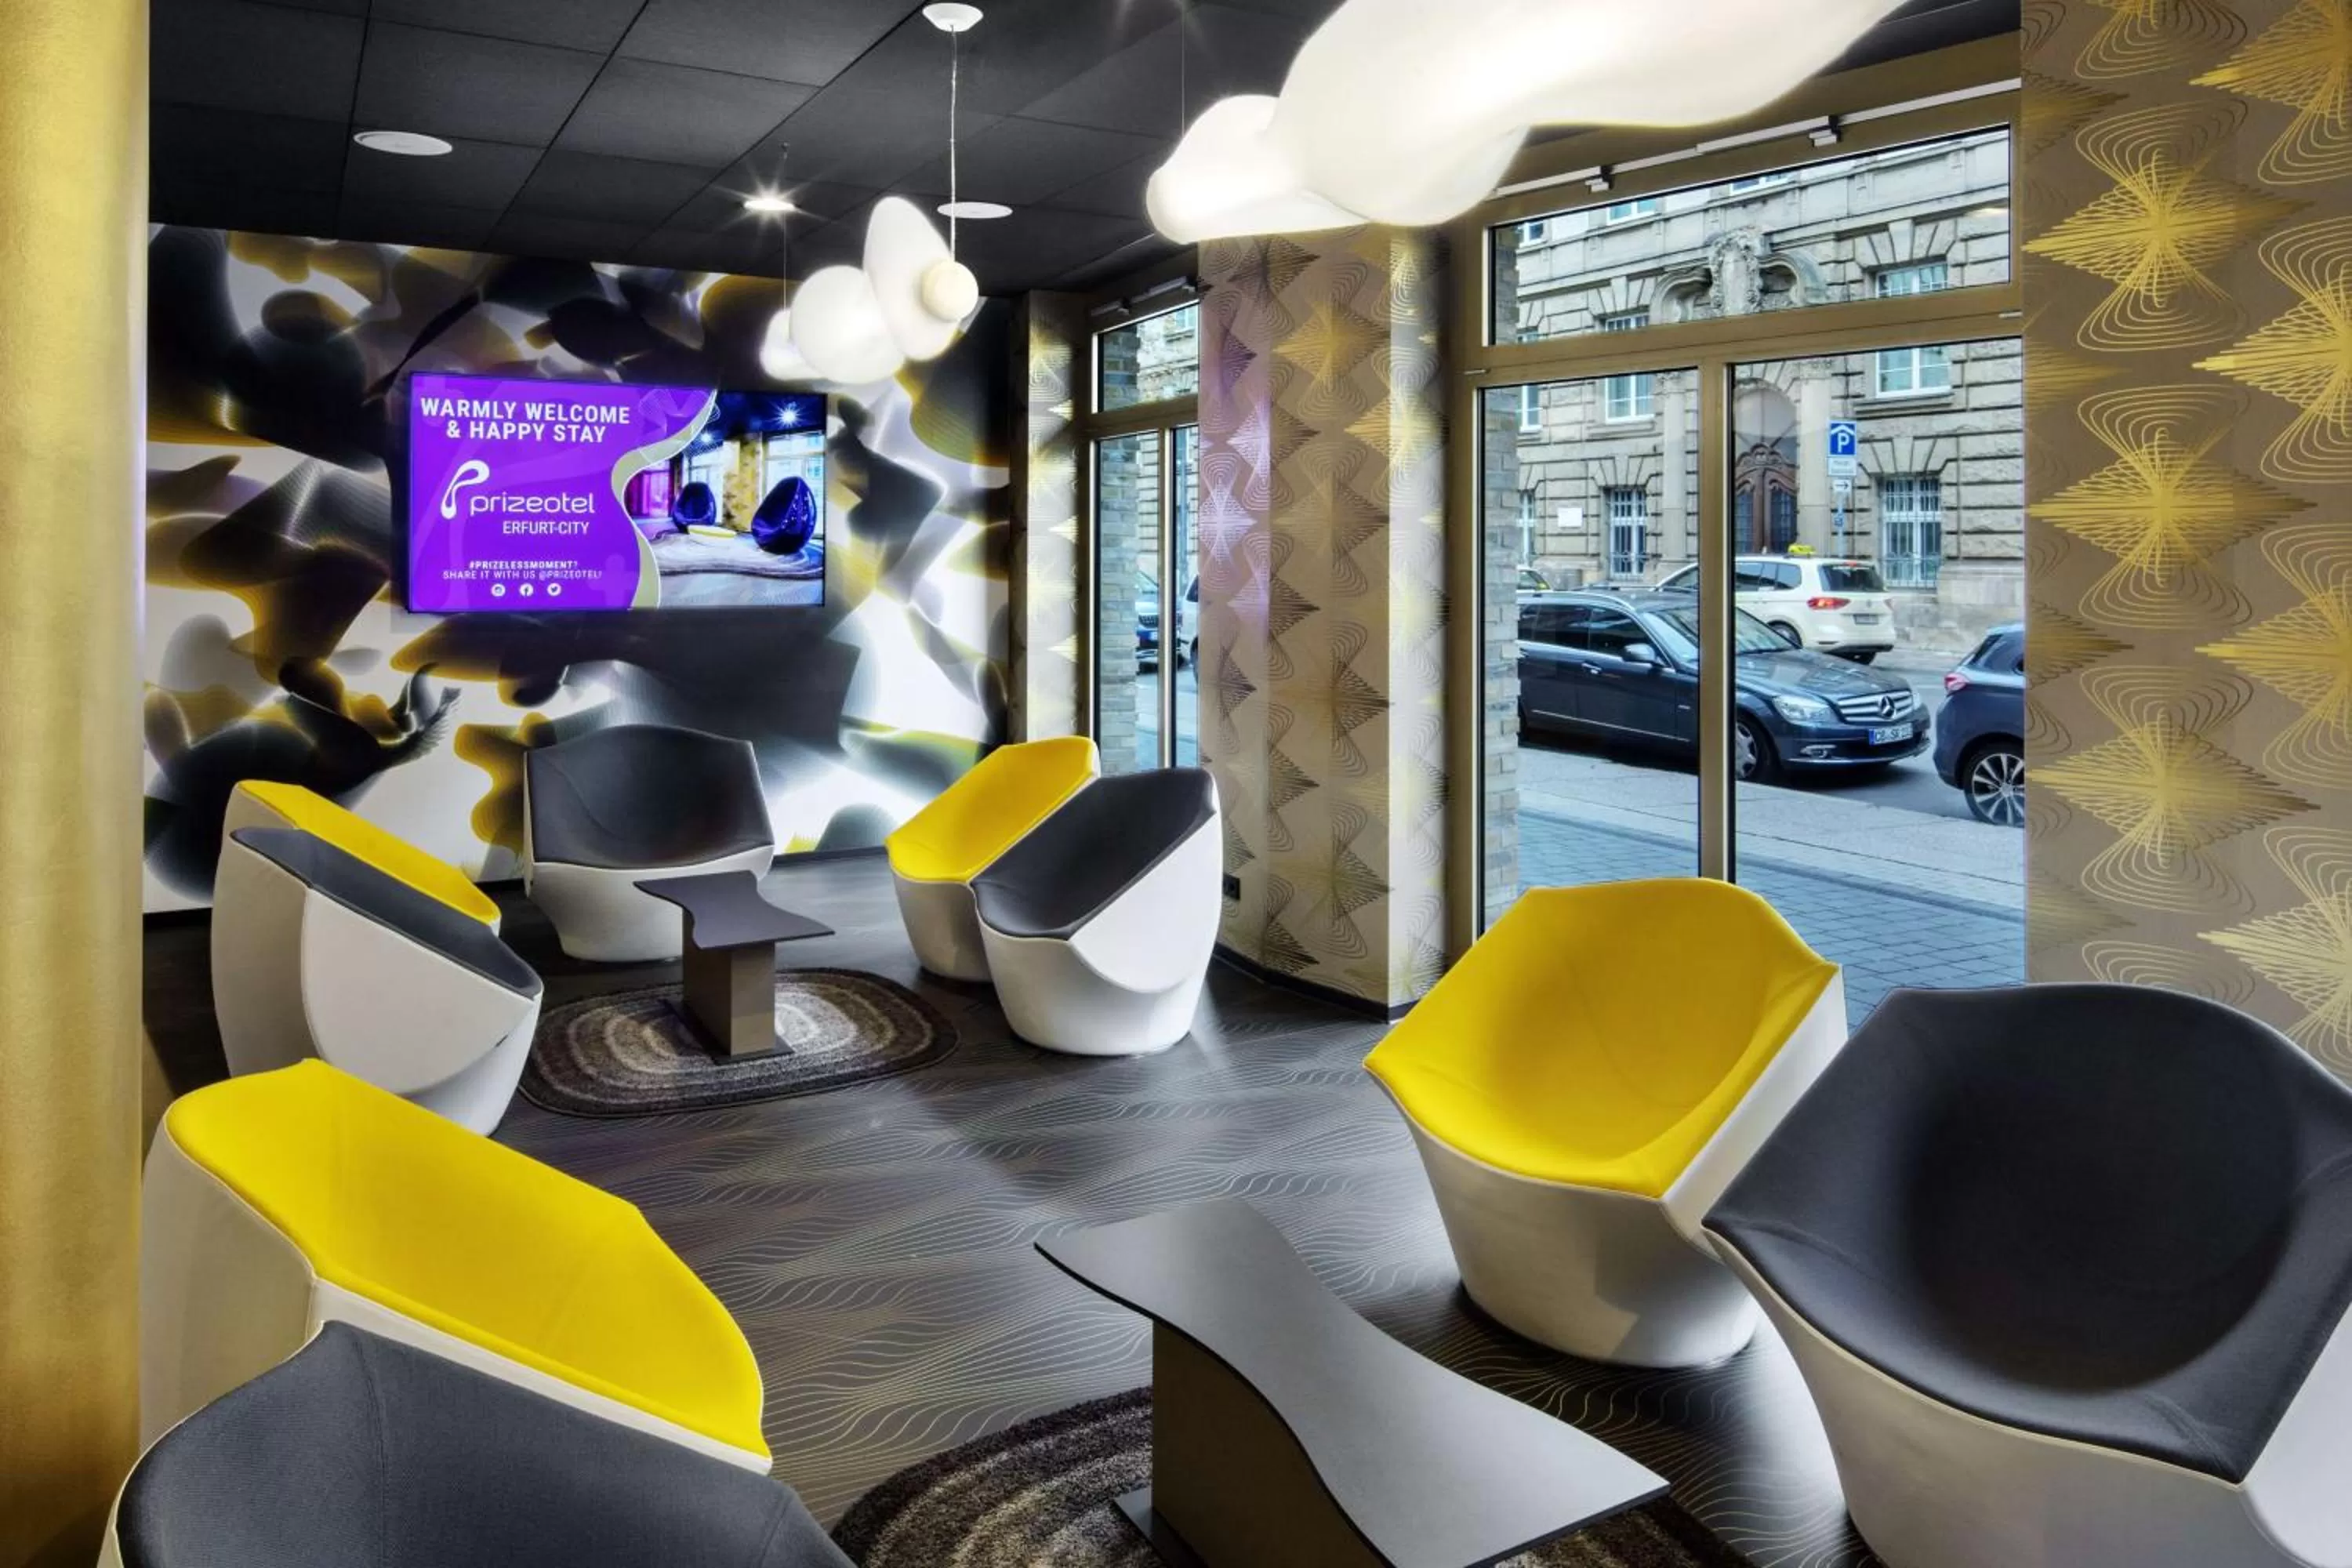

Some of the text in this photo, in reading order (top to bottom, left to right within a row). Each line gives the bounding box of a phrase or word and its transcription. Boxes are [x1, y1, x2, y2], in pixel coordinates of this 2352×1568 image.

[420, 397, 630, 424] WARMLY WELCOME
[446, 419, 606, 443] & HAPPY STAY
[1838, 432, 1849, 453] P
[470, 491, 596, 517] prizeotel
[503, 520, 590, 535] ERFURT-CITY
[442, 570, 477, 579] SHARE
[481, 571, 489, 579] IT
[493, 571, 521, 579] WITH
[523, 571, 535, 579] US
